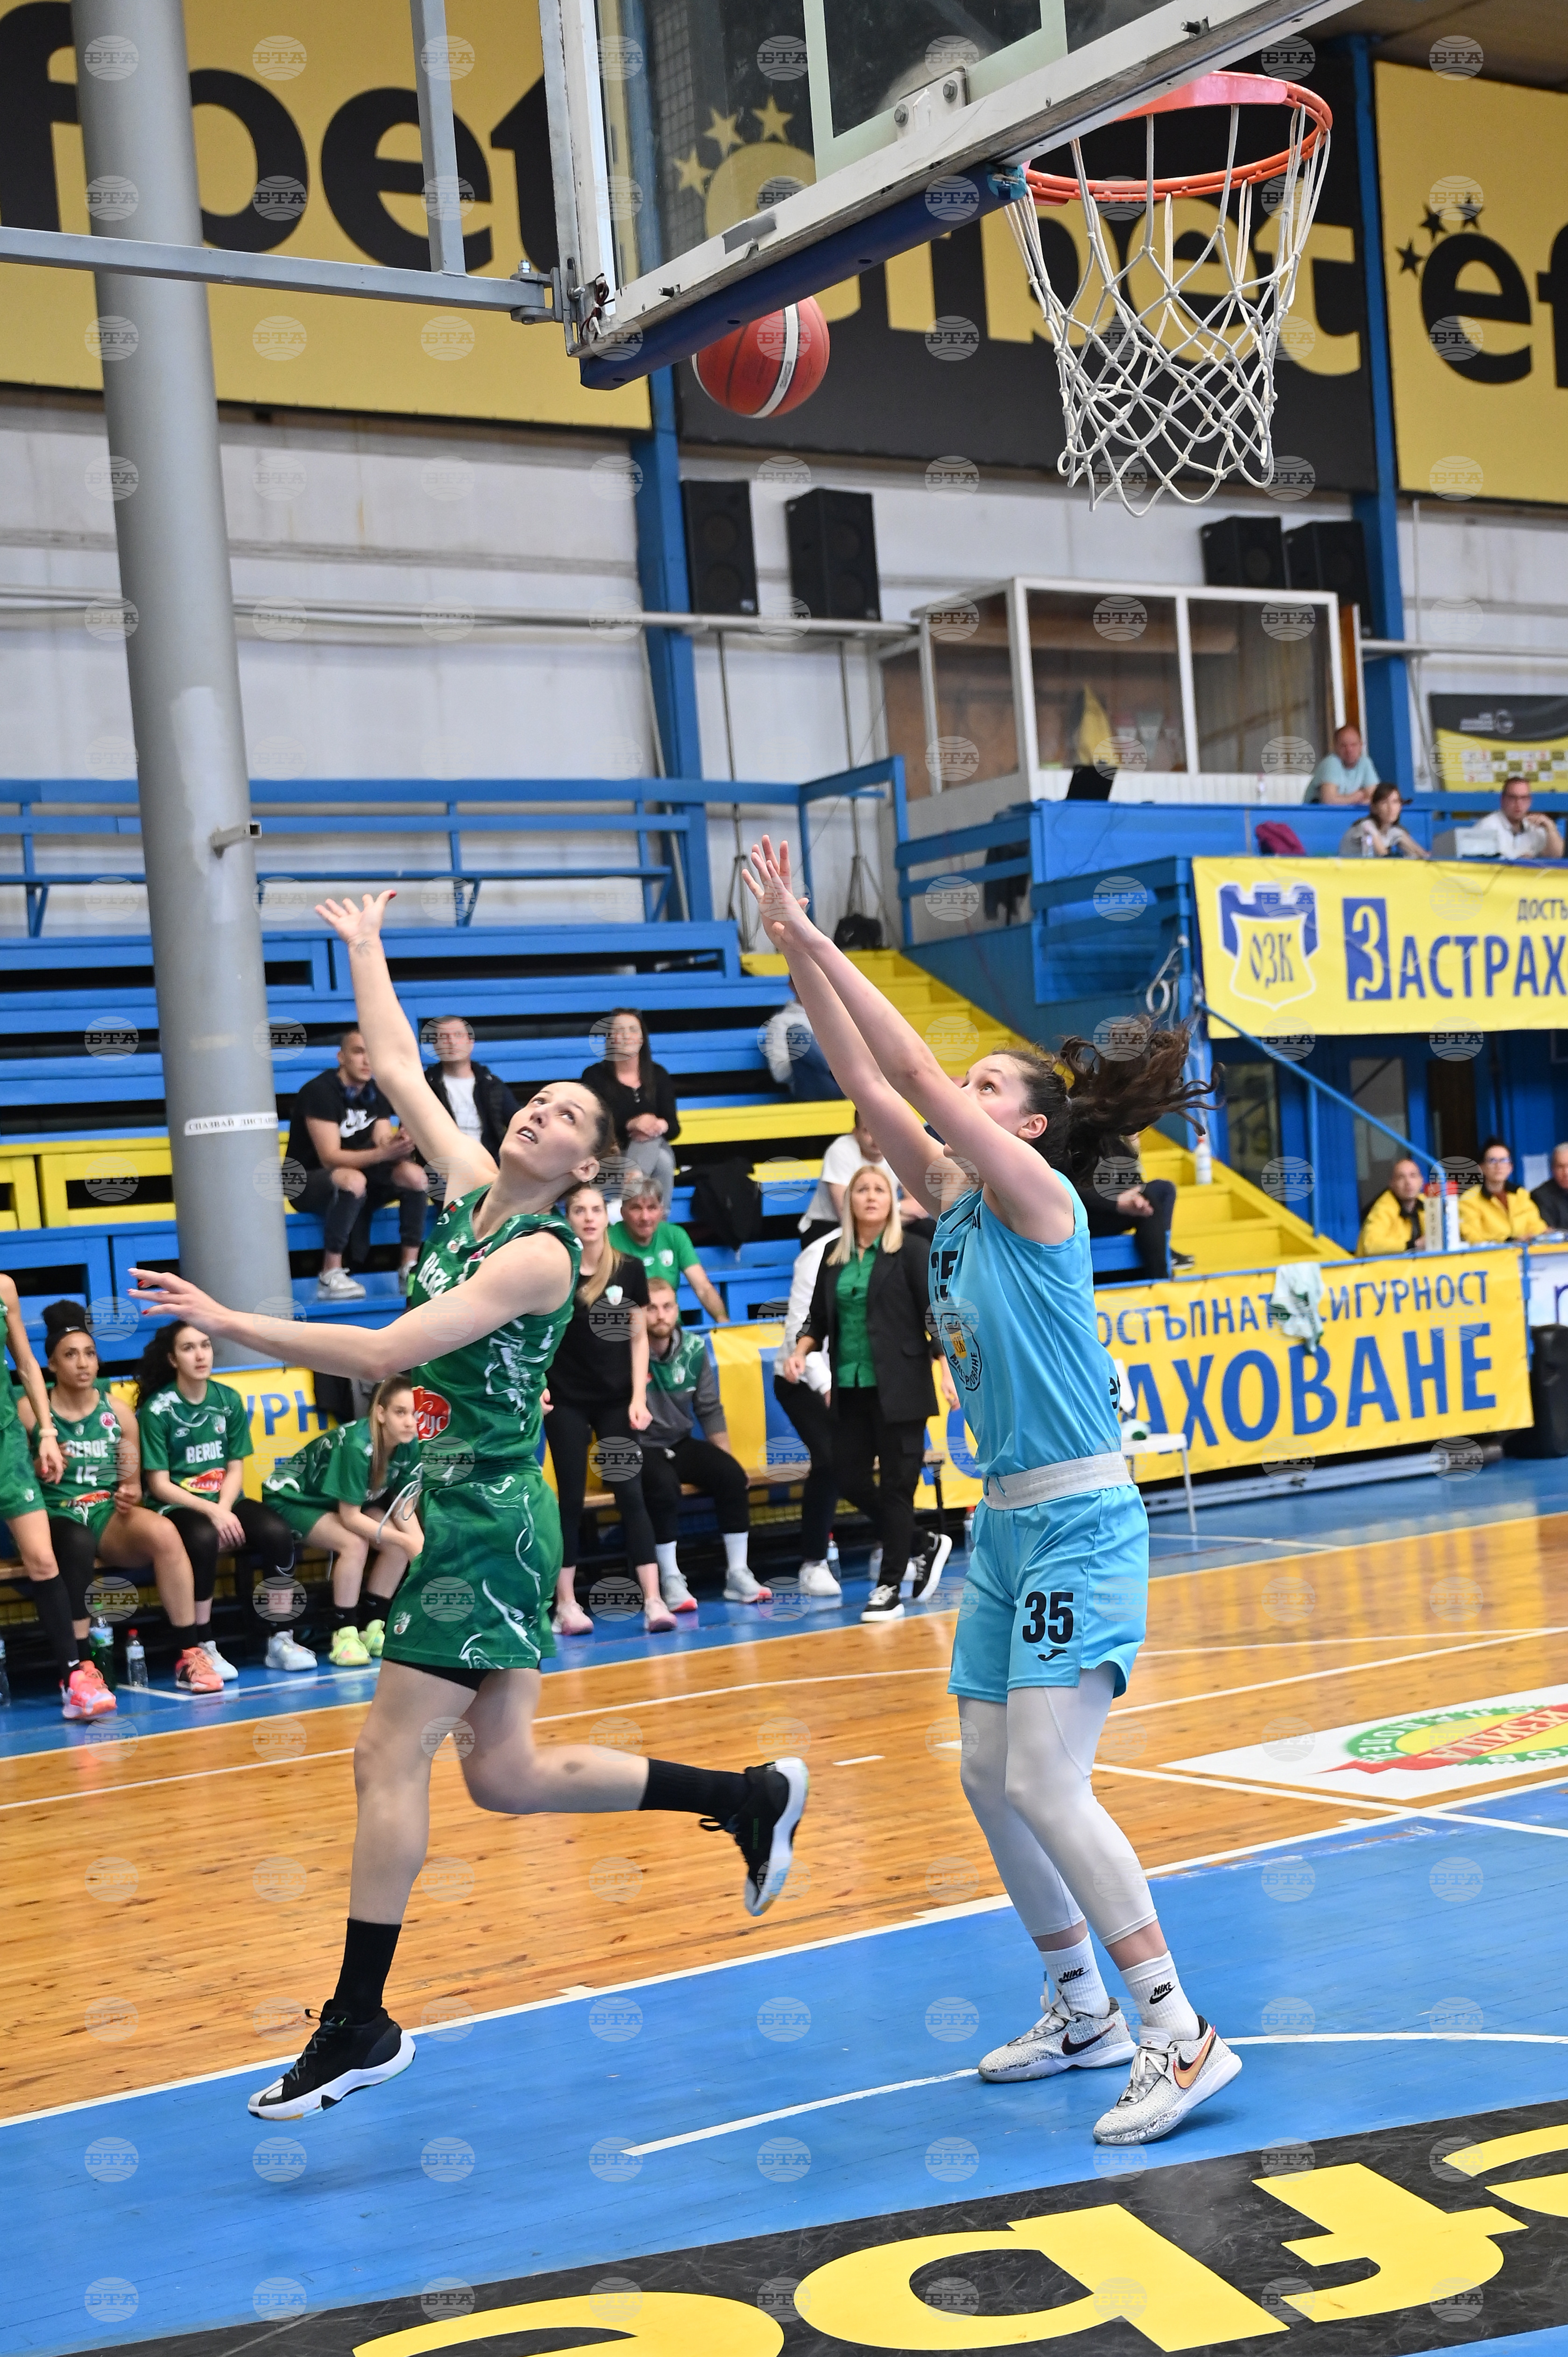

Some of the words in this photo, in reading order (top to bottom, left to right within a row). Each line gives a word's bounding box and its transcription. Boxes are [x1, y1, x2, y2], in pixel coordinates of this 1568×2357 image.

[1320, 1270, 1488, 1322] ИГУРНОСТ
[185, 1440, 225, 1464] BEROE
[1023, 1591, 1074, 1643] 35
[1062, 1967, 1084, 1980] NIKE
[1153, 1982, 1172, 1996] NIKE
